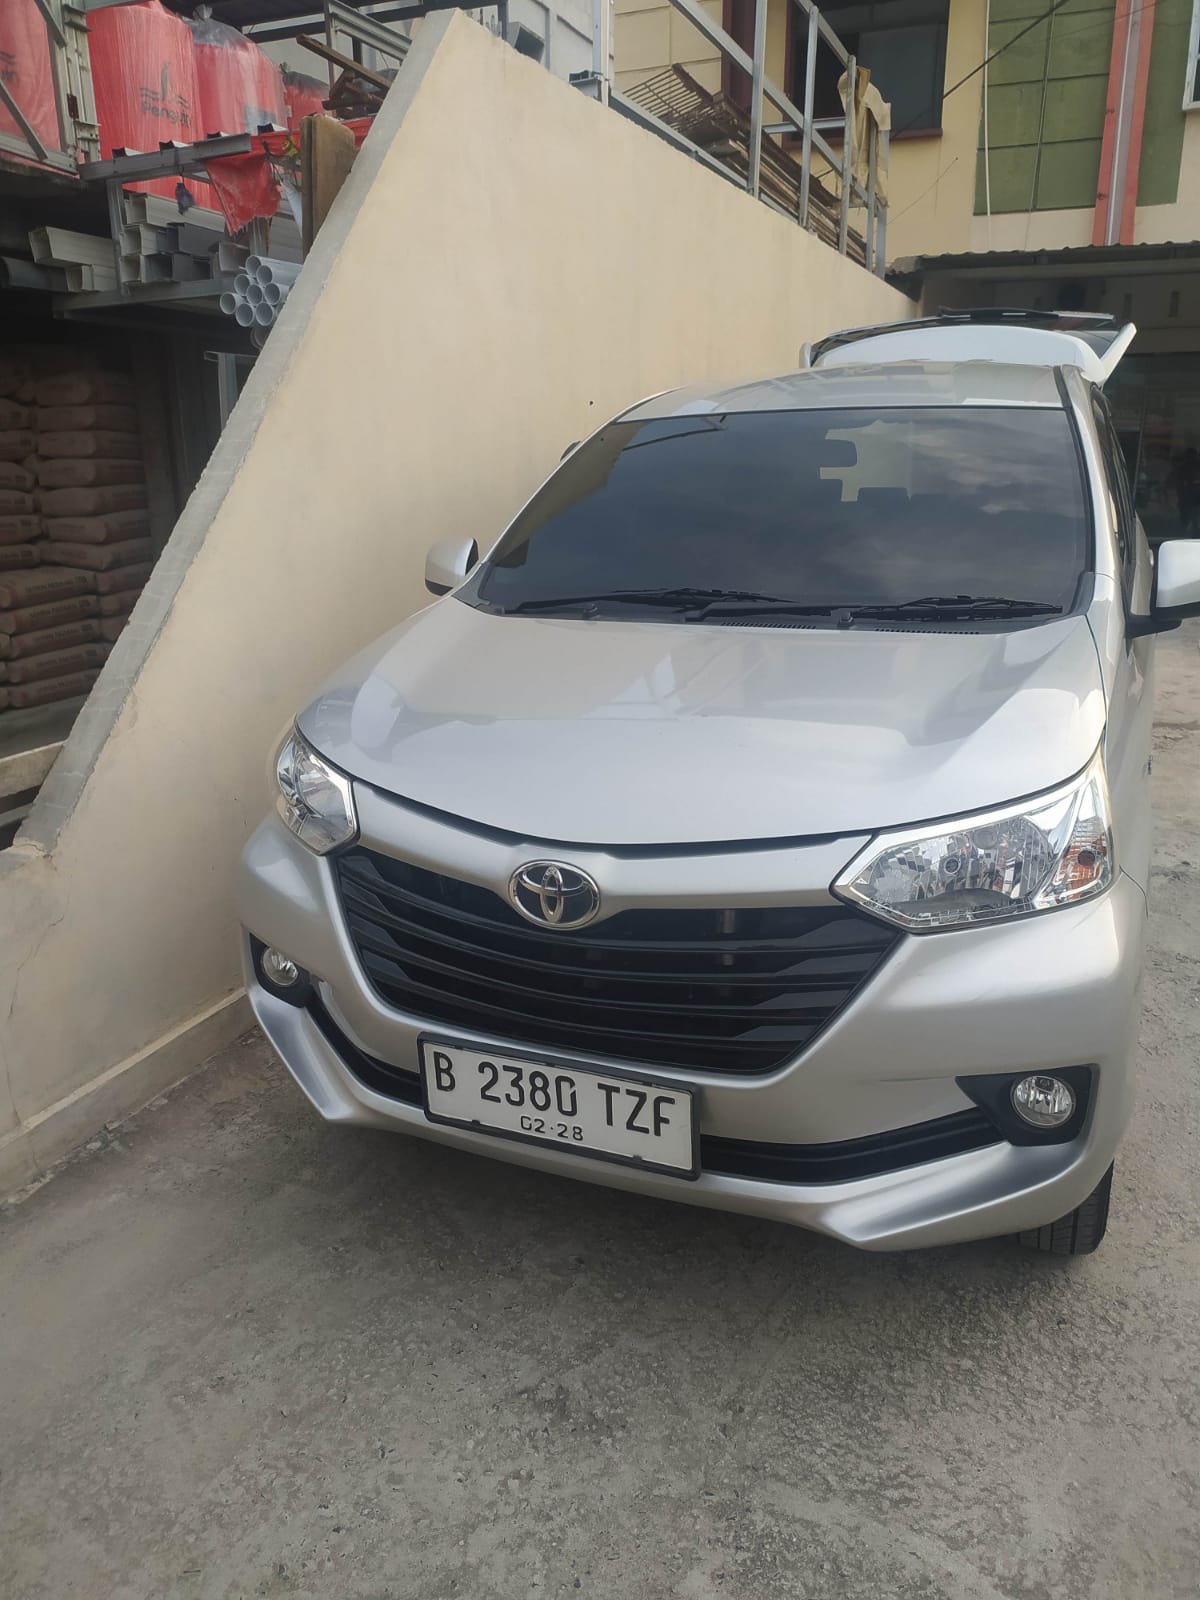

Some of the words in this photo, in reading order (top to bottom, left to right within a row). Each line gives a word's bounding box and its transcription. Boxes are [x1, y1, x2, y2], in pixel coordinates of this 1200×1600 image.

[433, 1051, 456, 1092] B
[478, 1062, 578, 1117] 2380
[597, 1082, 676, 1137] TZF
